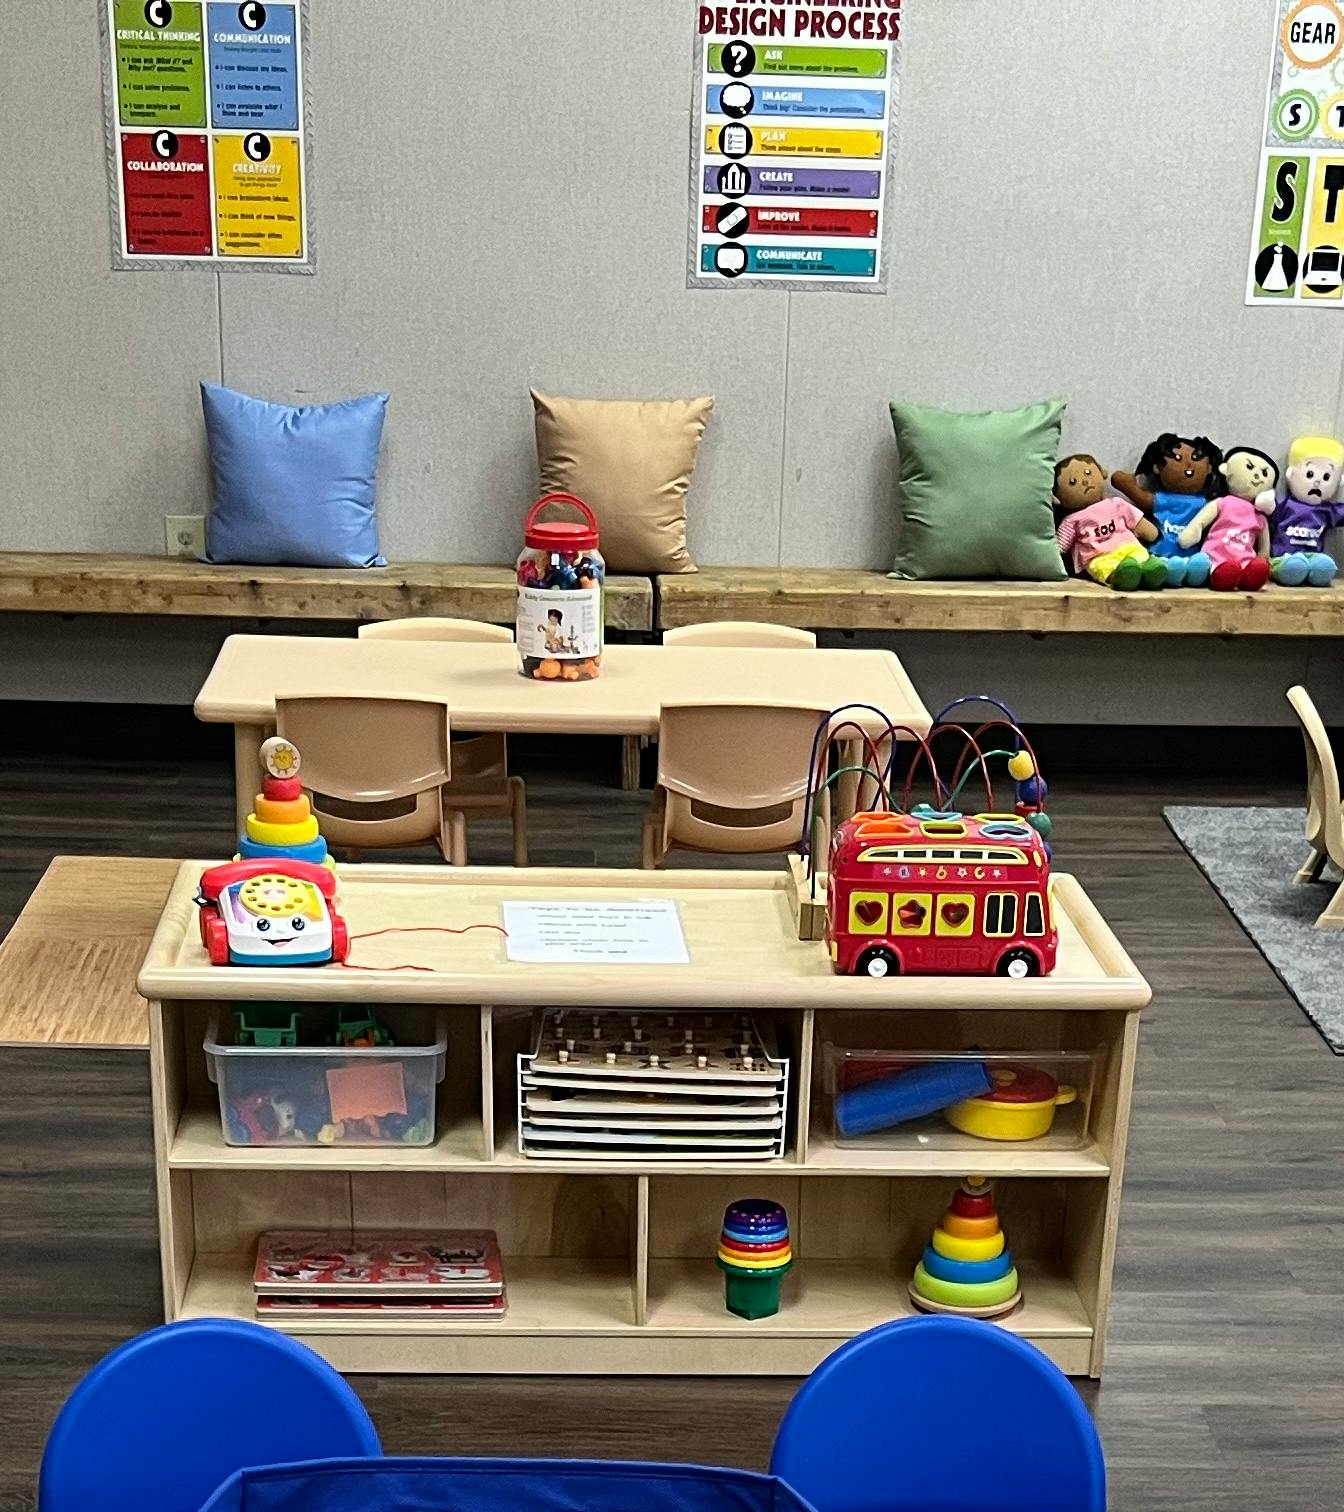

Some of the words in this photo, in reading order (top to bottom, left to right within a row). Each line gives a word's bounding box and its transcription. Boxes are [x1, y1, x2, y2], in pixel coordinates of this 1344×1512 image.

[698, 6, 786, 37] DESIGN
[794, 10, 900, 41] PROCESS
[117, 30, 156, 40] CRITICAL
[158, 32, 200, 42] THINKING
[214, 32, 291, 44] COMMUNICATION
[1290, 22, 1336, 44] GEAR
[764, 50, 782, 60] ASK
[762, 91, 803, 101] IMAGINE
[127, 161, 204, 172] COLLABORATION
[232, 163, 281, 175] CREATIVITY
[760, 172, 793, 182] CREATE
[758, 210, 800, 221] IMPROVE
[756, 250, 822, 261] COMMUNICATE
[1286, 525, 1324, 537] scared
